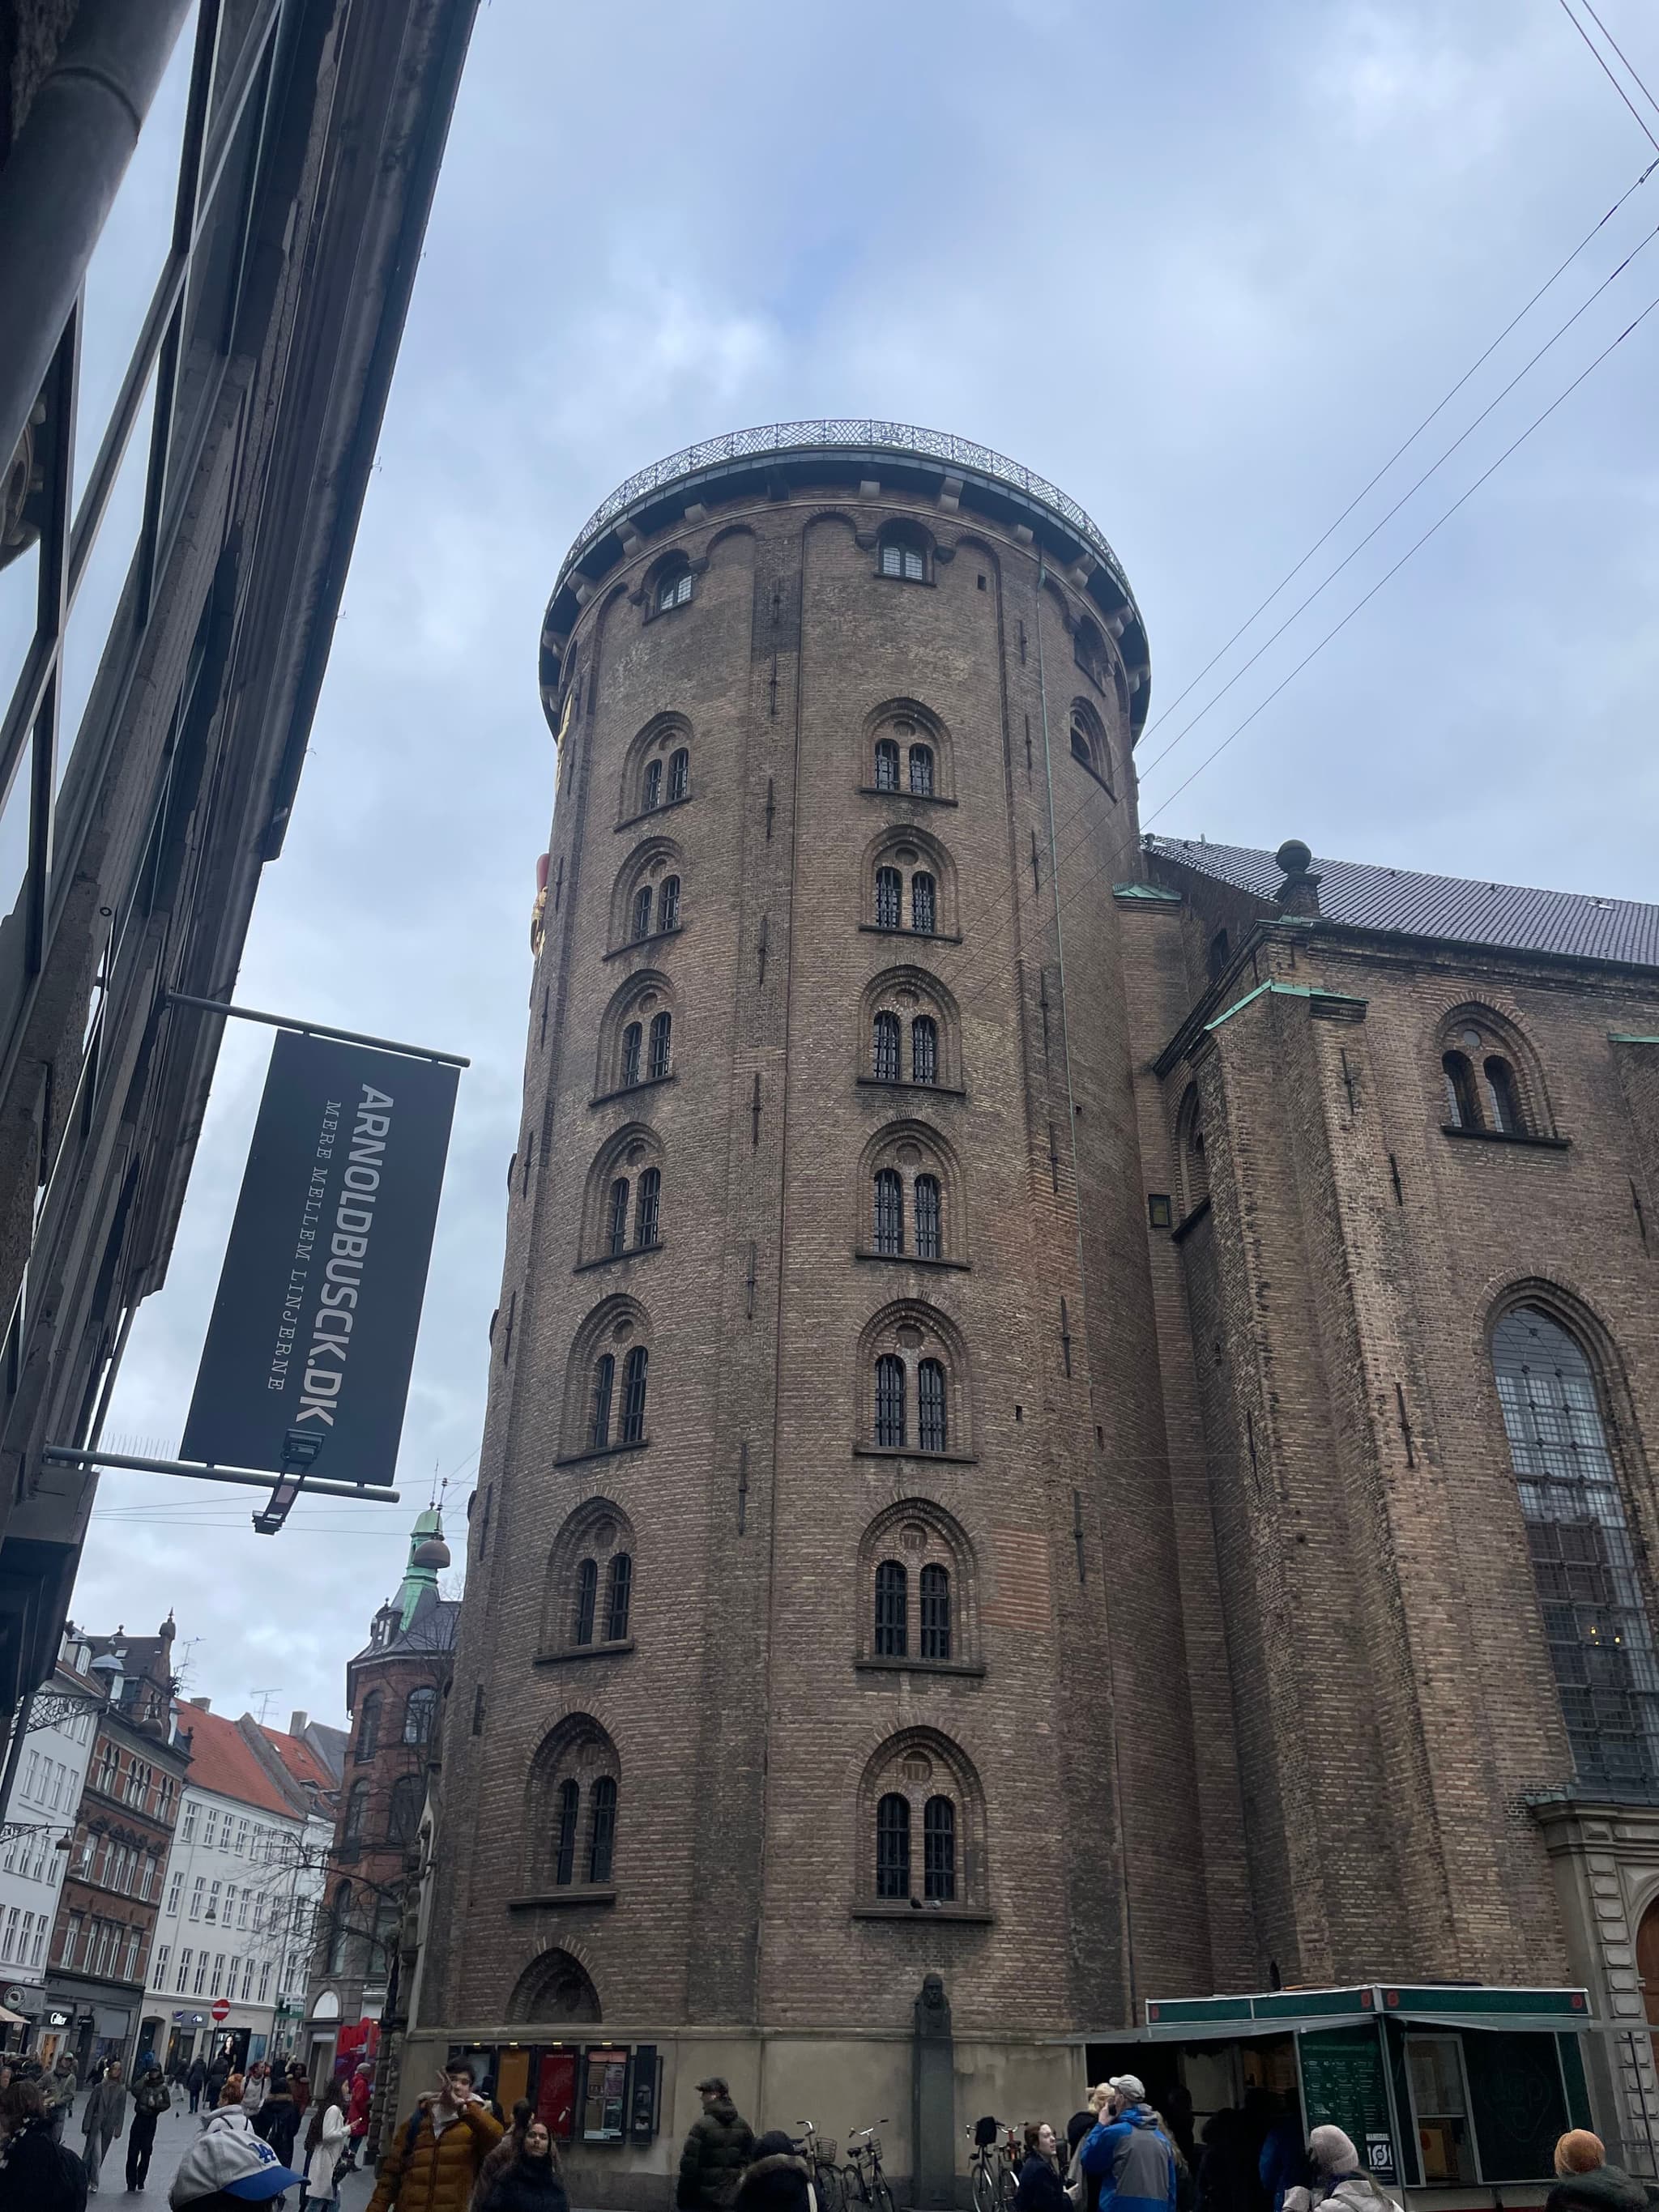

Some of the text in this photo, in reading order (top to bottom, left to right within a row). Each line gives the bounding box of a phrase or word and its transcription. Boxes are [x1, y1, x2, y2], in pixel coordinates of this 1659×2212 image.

[267, 1099, 342, 1391] MERE MELLEM LINJERNE
[296, 1083, 394, 1426] ARNOLDBUSCK.DK
